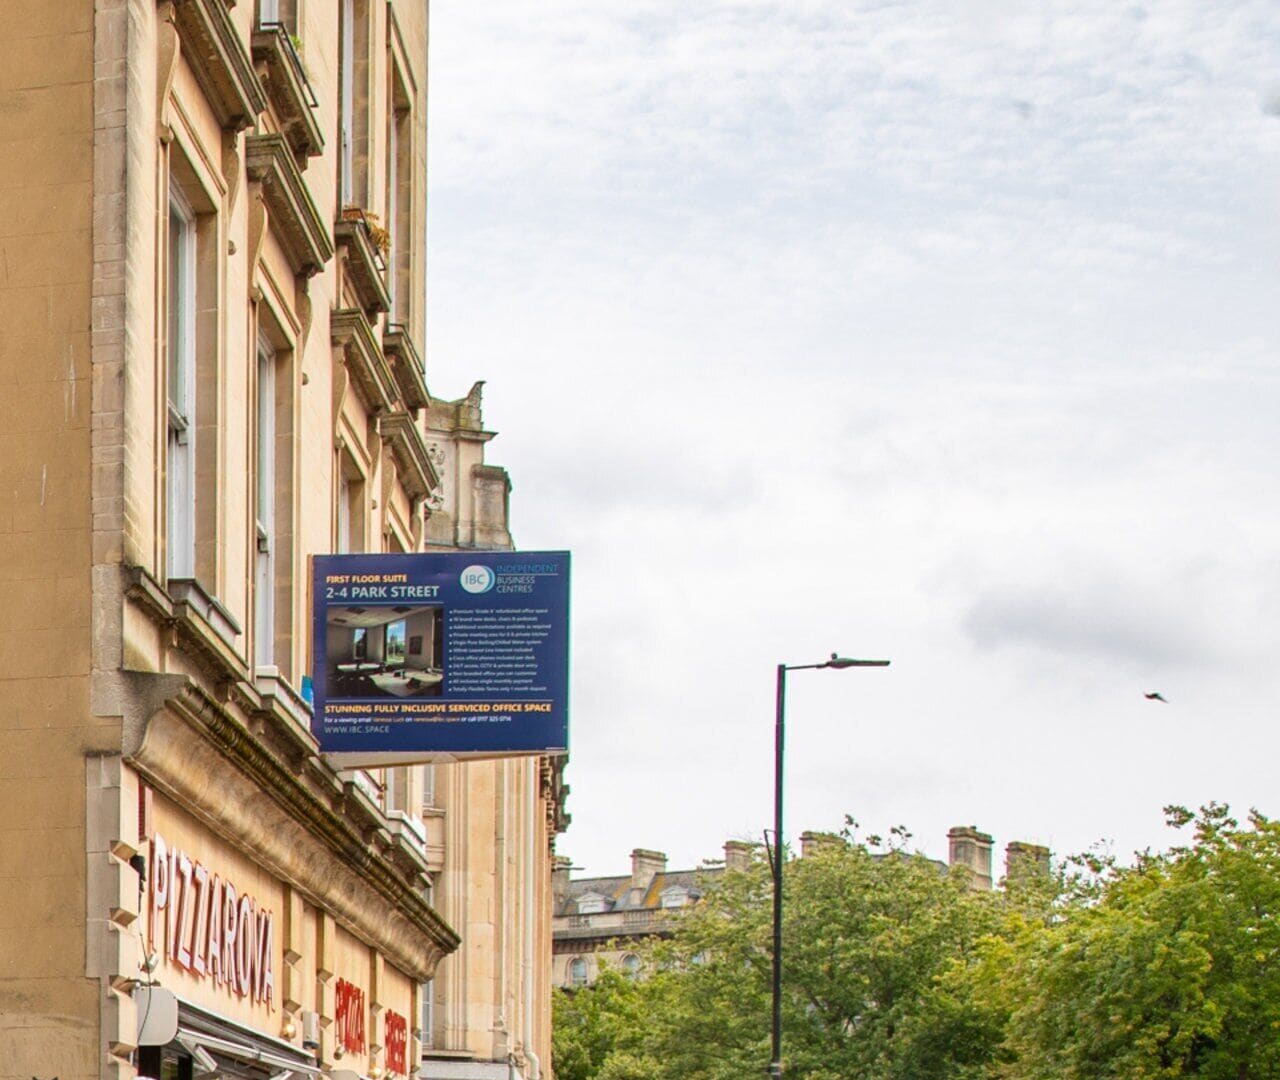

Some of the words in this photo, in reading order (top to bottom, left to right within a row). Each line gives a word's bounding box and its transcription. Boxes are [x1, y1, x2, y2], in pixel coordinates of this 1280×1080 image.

[496, 565, 558, 573] INDEPENDENT
[326, 575, 350, 584] FIRST
[351, 574, 381, 583] FLOOR
[382, 574, 407, 583] SUITE
[465, 574, 485, 585] IBC
[497, 576, 535, 584] BUSINESS
[326, 587, 348, 598] 2-4
[351, 586, 387, 598] PARK
[390, 585, 440, 597] STREET
[496, 585, 534, 593] CENTRES
[324, 704, 372, 714] STUNNING
[373, 704, 400, 713] FULLY
[401, 703, 446, 713] INCLUSIVE
[448, 703, 491, 713] SERVICED
[492, 703, 522, 712] OFFICE
[524, 703, 552, 712] SPACE
[324, 725, 390, 734] WWW.IBC.SPACE
[148, 831, 276, 1013] PIZZAROVA
